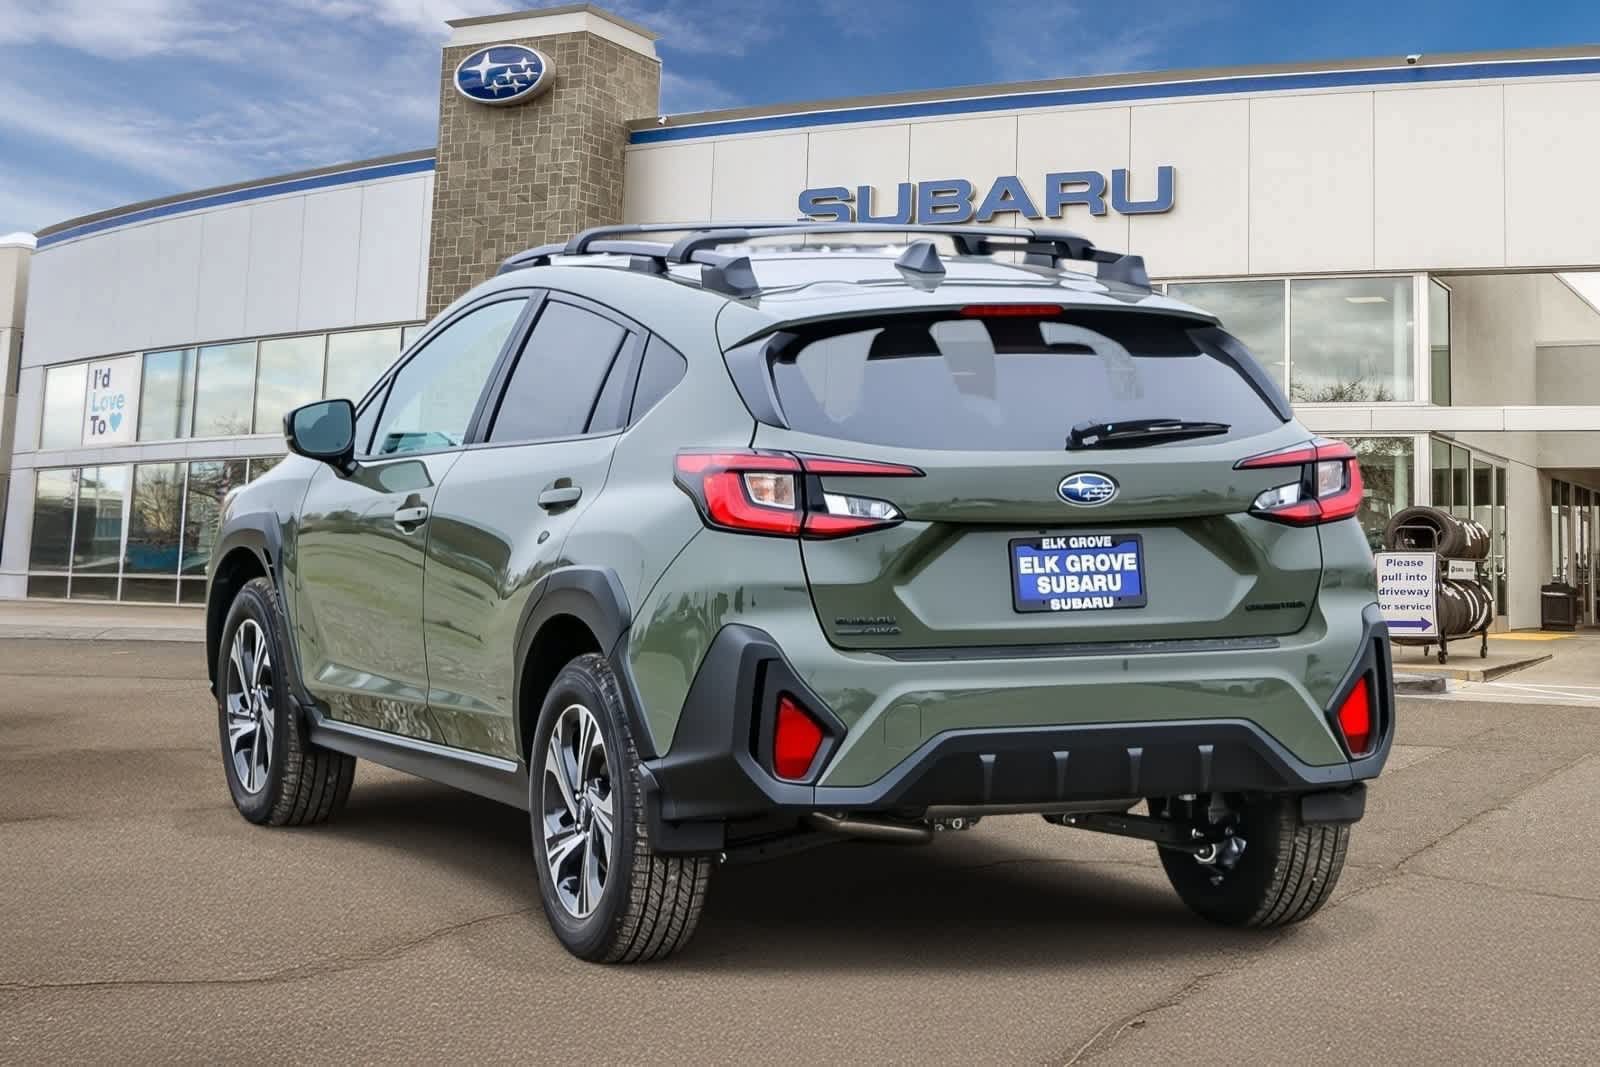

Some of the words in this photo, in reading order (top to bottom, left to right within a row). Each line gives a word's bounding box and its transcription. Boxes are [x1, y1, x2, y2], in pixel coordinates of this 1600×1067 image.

[798, 166, 1174, 225] SUBARU
[93, 367, 111, 390] I'd
[91, 391, 125, 412] Love
[90, 415, 106, 435] To
[1042, 538, 1066, 549] ELK
[1069, 536, 1112, 548] GROVE
[1019, 555, 1060, 574] ELK
[1065, 552, 1137, 573] GROVE
[1386, 558, 1424, 567] Please
[1037, 573, 1122, 594] SUBARU
[1381, 572, 1402, 583] pull
[1405, 573, 1428, 582] into
[1378, 587, 1430, 598] driveway
[1050, 596, 1114, 610] SUBARU
[1394, 603, 1432, 611] service
